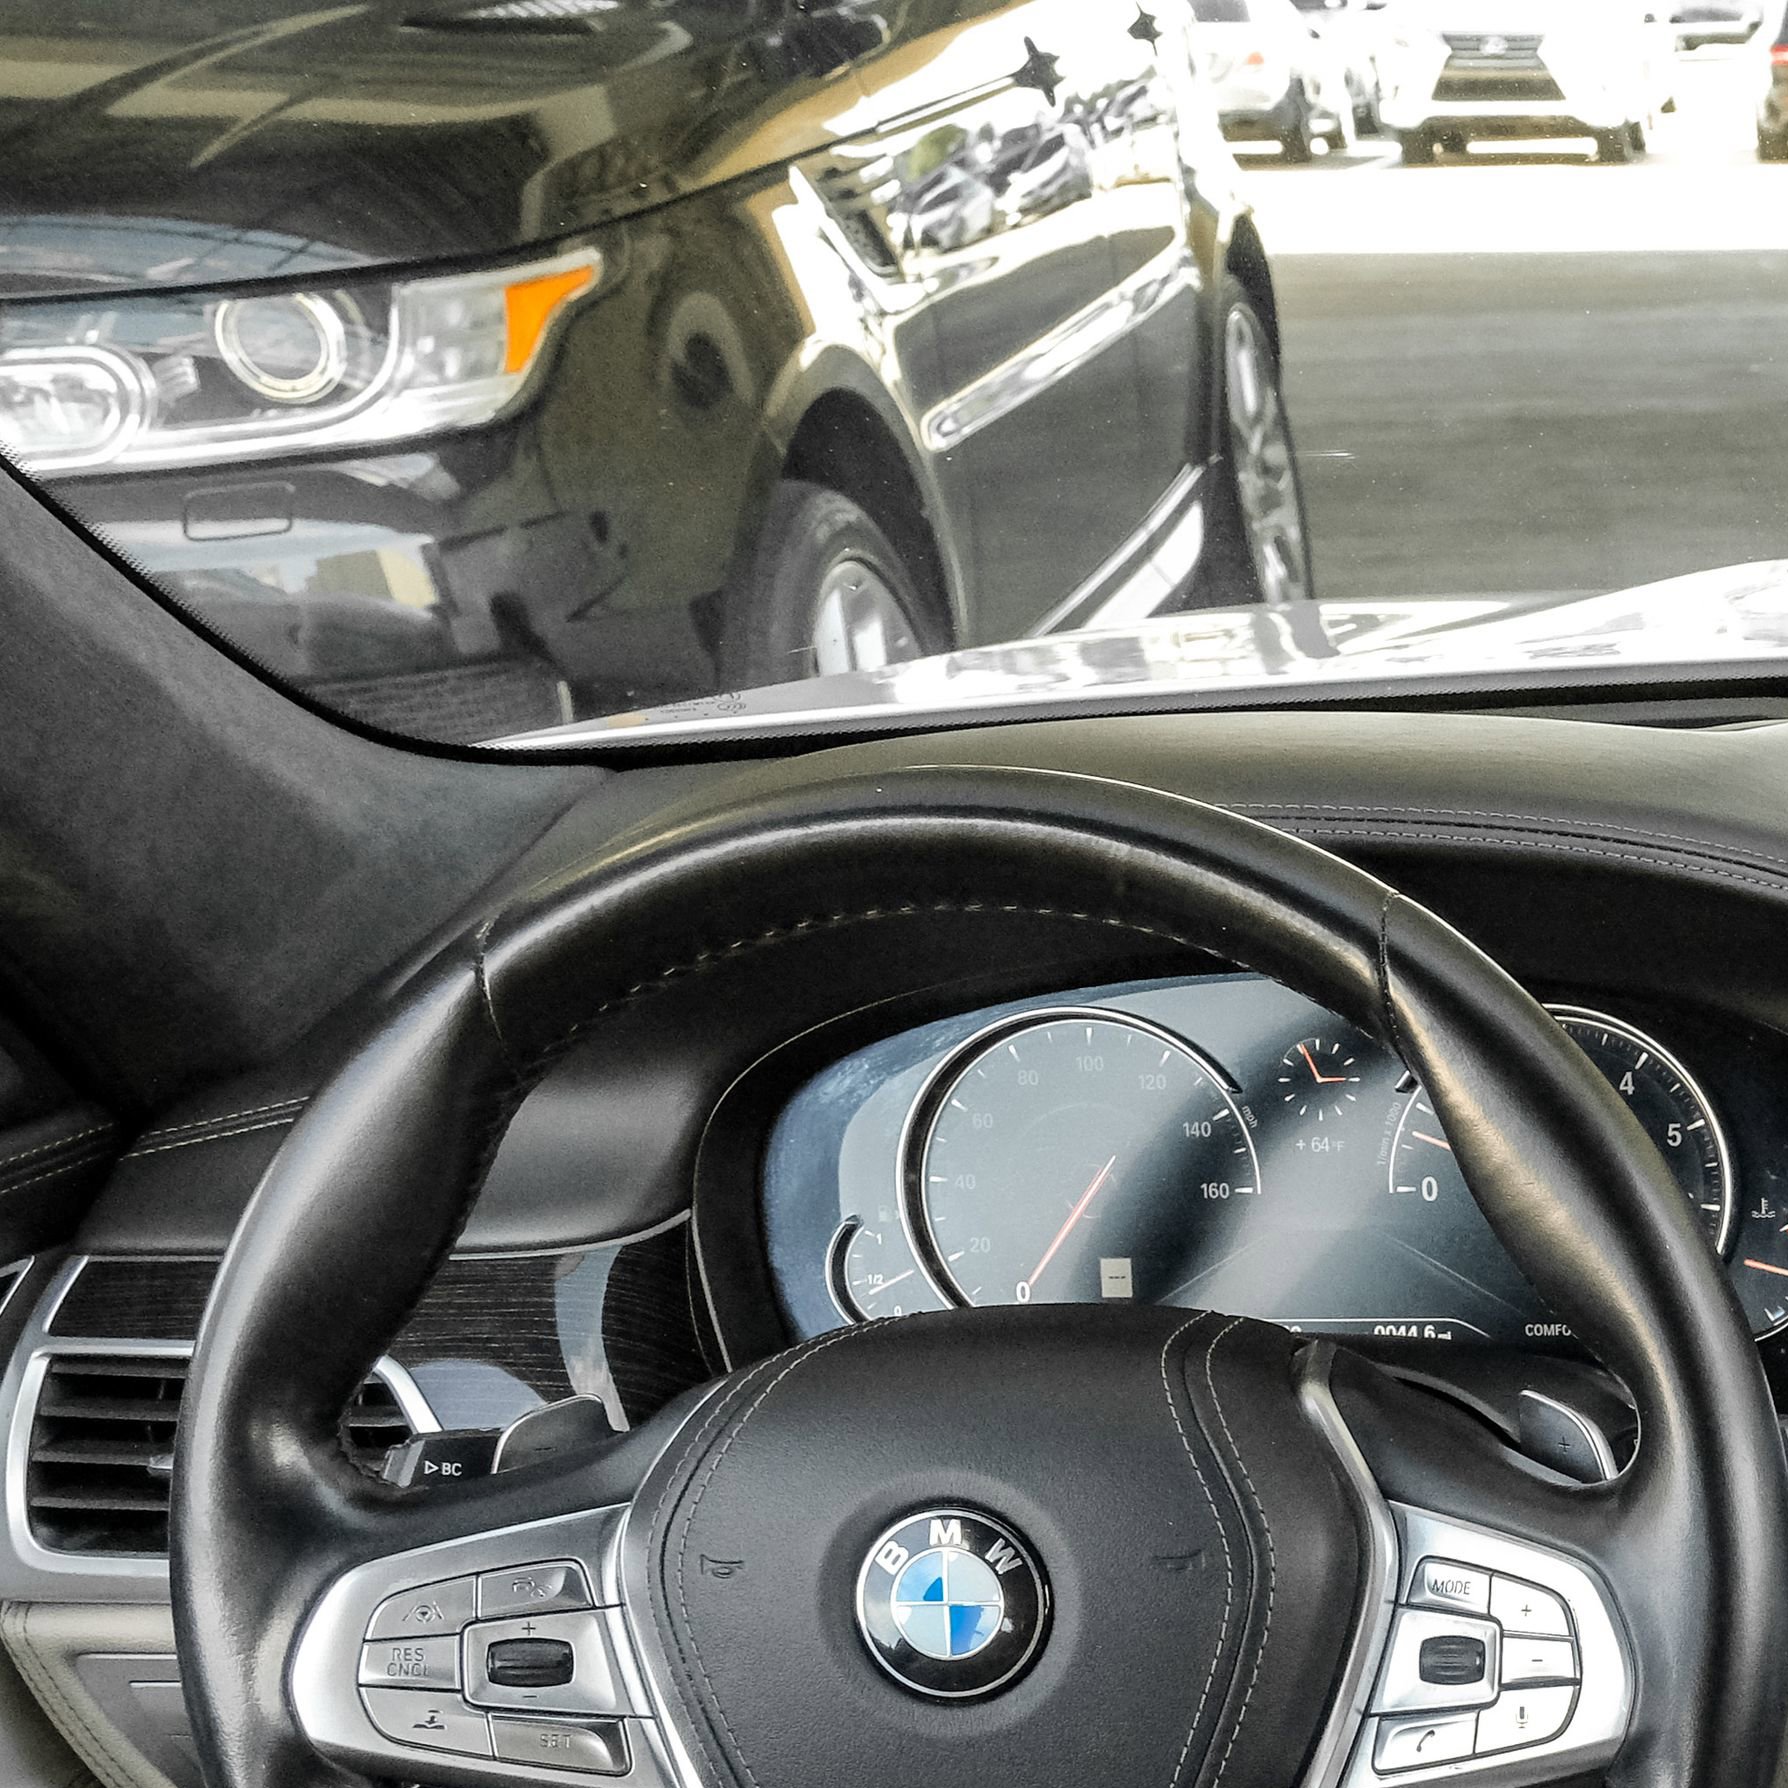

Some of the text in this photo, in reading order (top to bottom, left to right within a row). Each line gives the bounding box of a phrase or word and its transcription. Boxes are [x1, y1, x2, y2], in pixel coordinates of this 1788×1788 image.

[1075, 1056, 1104, 1072] 100
[1016, 1069, 1039, 1087] 80
[1138, 1074, 1167, 1091] 120
[1618, 1071, 1635, 1095] 4
[972, 1113, 994, 1130] 60
[1241, 1104, 1258, 1129] mph
[1182, 1121, 1212, 1138] 140
[1666, 1123, 1682, 1147] 5
[955, 1174, 977, 1191] 40
[1200, 1182, 1231, 1199] 160
[1420, 1176, 1439, 1201] 0
[875, 1232, 882, 1245] 1
[970, 1236, 991, 1253] 20
[866, 1273, 884, 1285] 1/2
[1015, 1281, 1031, 1304] 0
[441, 1461, 462, 1477] BC
[874, 1518, 1024, 1576] BMW
[1431, 1578, 1472, 1596] MODE
[391, 1647, 425, 1662] RES
[386, 1662, 429, 1678] CNCL
[539, 1733, 573, 1749] SET
